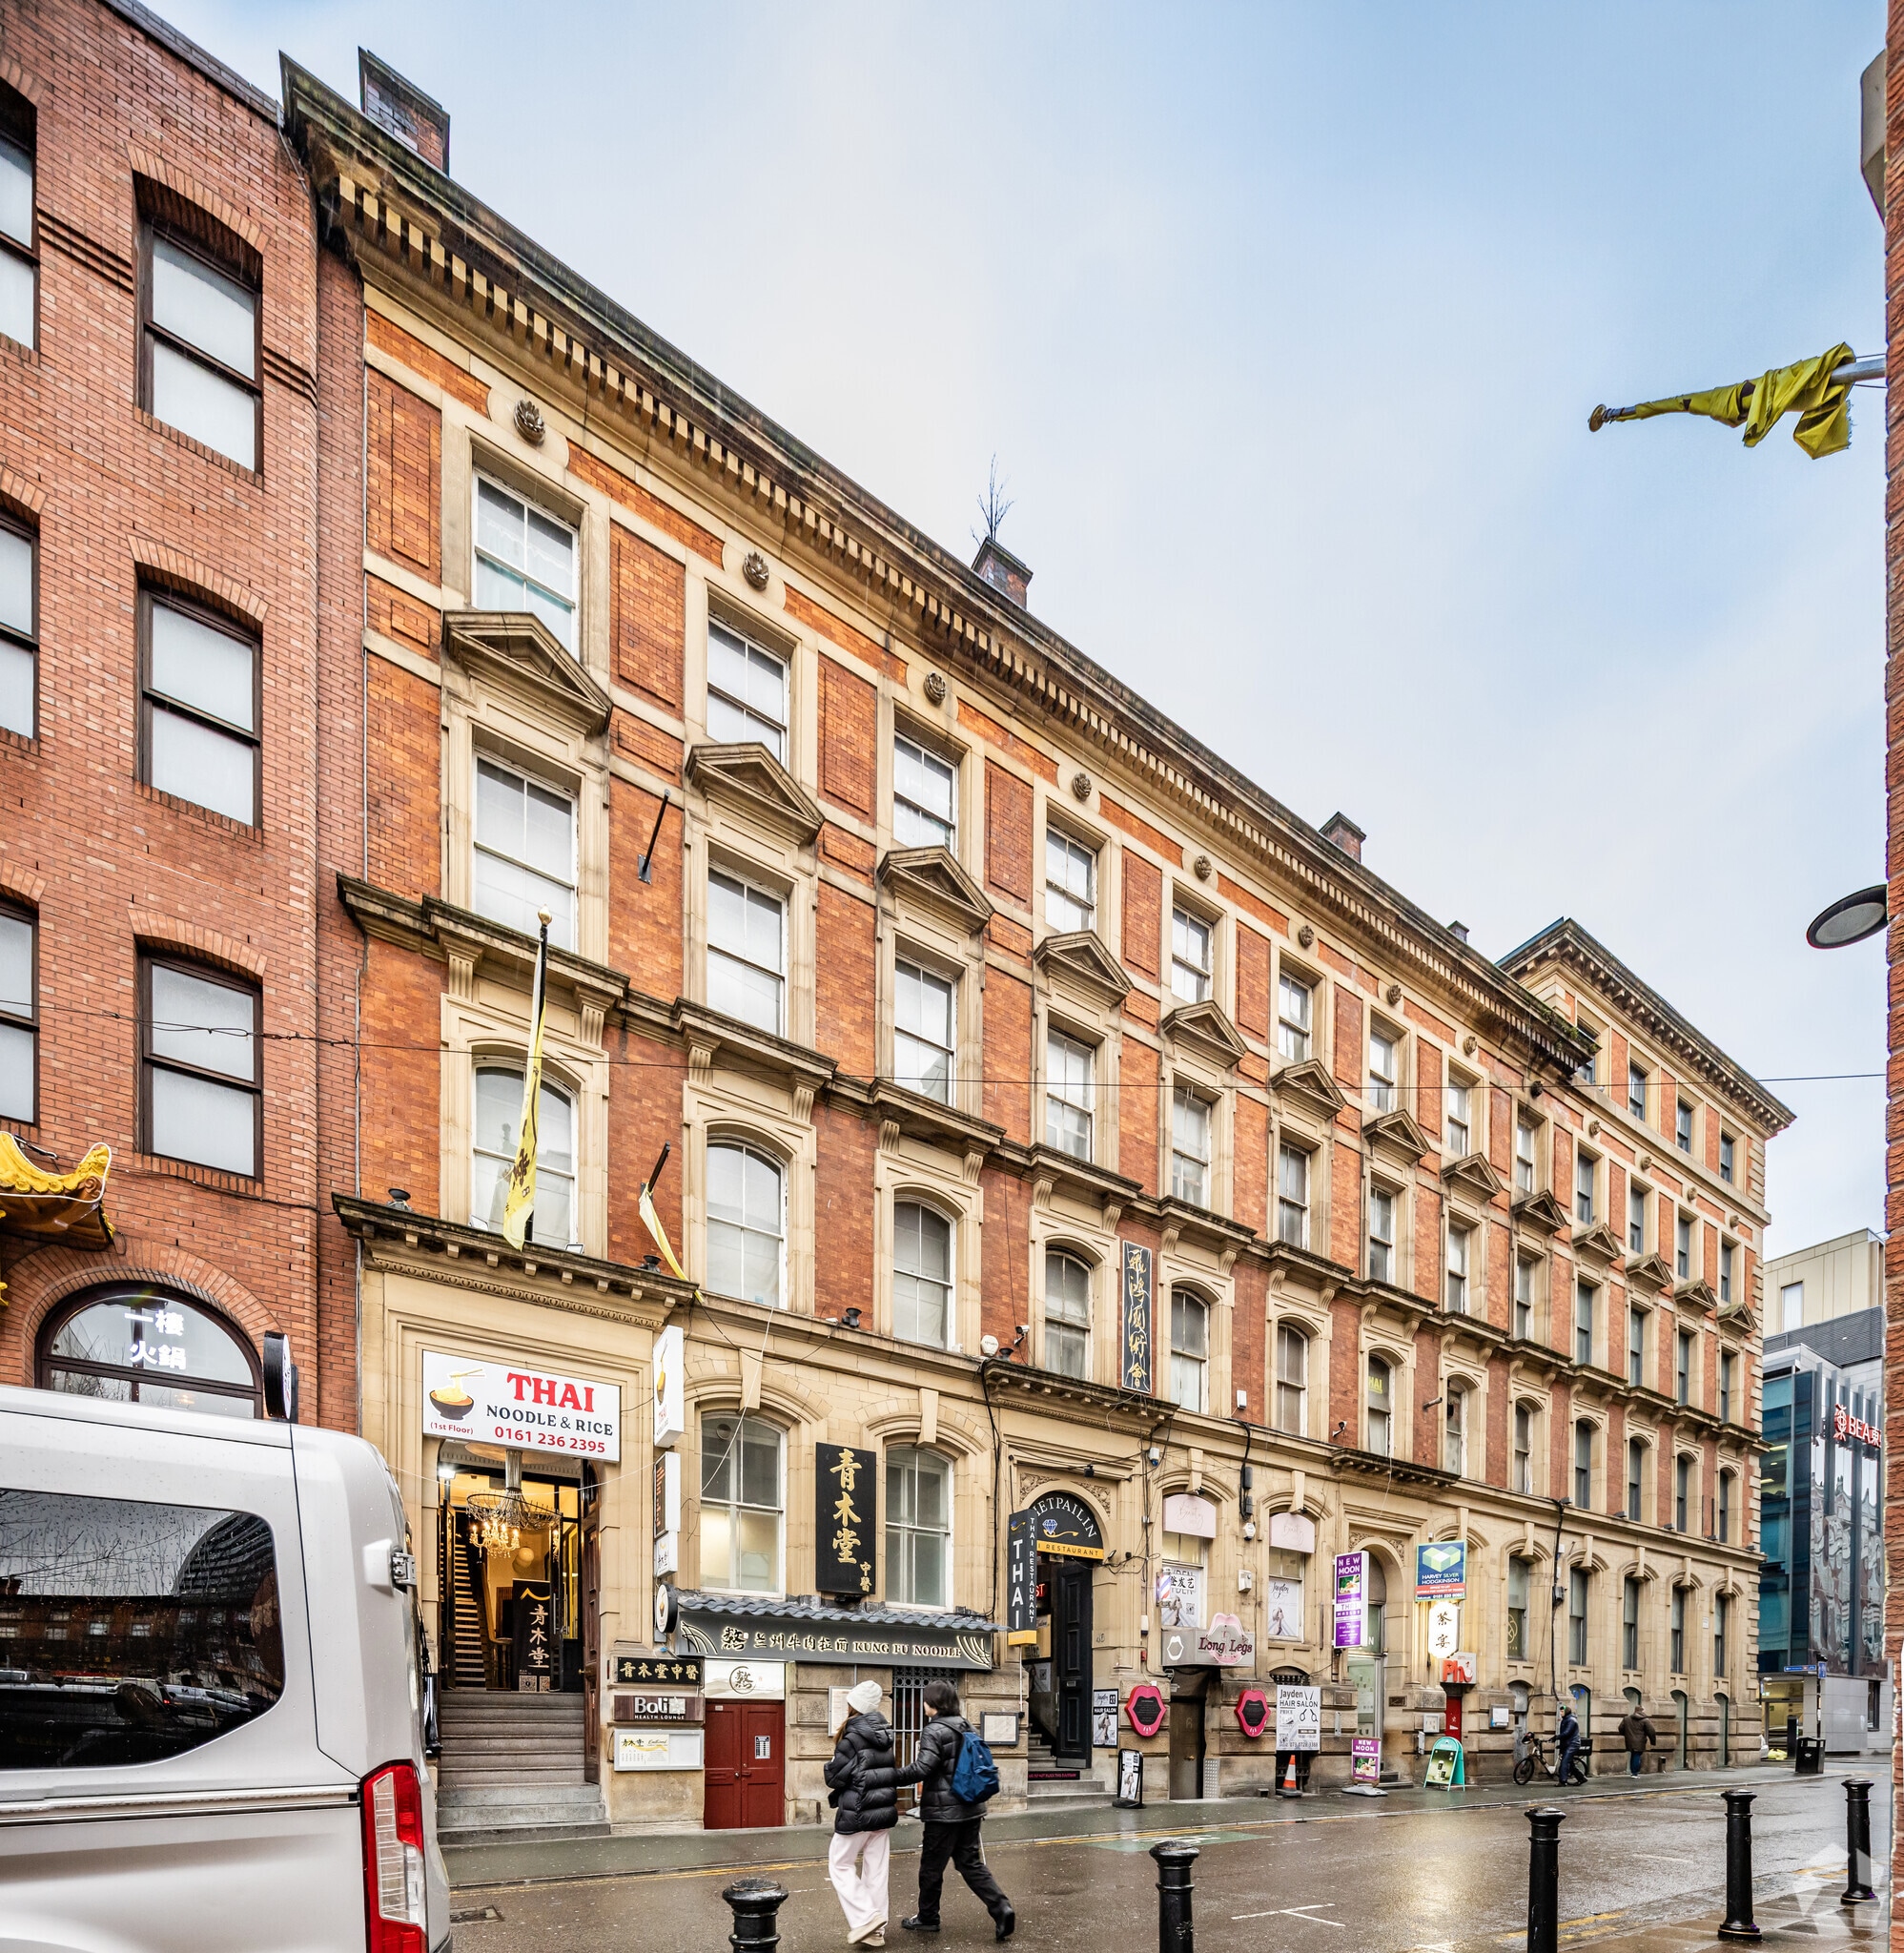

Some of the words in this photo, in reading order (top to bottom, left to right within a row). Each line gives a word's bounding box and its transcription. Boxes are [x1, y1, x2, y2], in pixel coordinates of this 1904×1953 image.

[129, 1340, 187, 1370] 火鍋
[506, 1372, 595, 1412] THAI
[430, 1422, 447, 1431] (1st
[448, 1424, 474, 1435] Floor)
[486, 1405, 557, 1427] NOODLE
[560, 1416, 571, 1429] &
[576, 1419, 613, 1436] RICE
[1849, 1415, 1871, 1444] BEA
[495, 1426, 532, 1442] 0161
[538, 1432, 565, 1448] 236
[569, 1437, 605, 1453] 2395
[829, 1448, 862, 1564] 青木堂
[1033, 1496, 1097, 1538] ETPAILIN
[1046, 1544, 1099, 1556] RESTAURANT
[1339, 1556, 1361, 1567] NEW
[1338, 1565, 1361, 1575] MOON
[1012, 1539, 1024, 1630] THAI
[527, 1604, 550, 1668] 青木堂
[1198, 1636, 1225, 1654] Long
[1229, 1639, 1253, 1655] Legs
[852, 1641, 890, 1654] KUNG
[892, 1643, 909, 1655] FU
[912, 1644, 961, 1657] NOODLE
[620, 1661, 699, 1680] 青木堂中醫
[634, 1696, 667, 1714] Bali
[1280, 1689, 1303, 1699] Jayden
